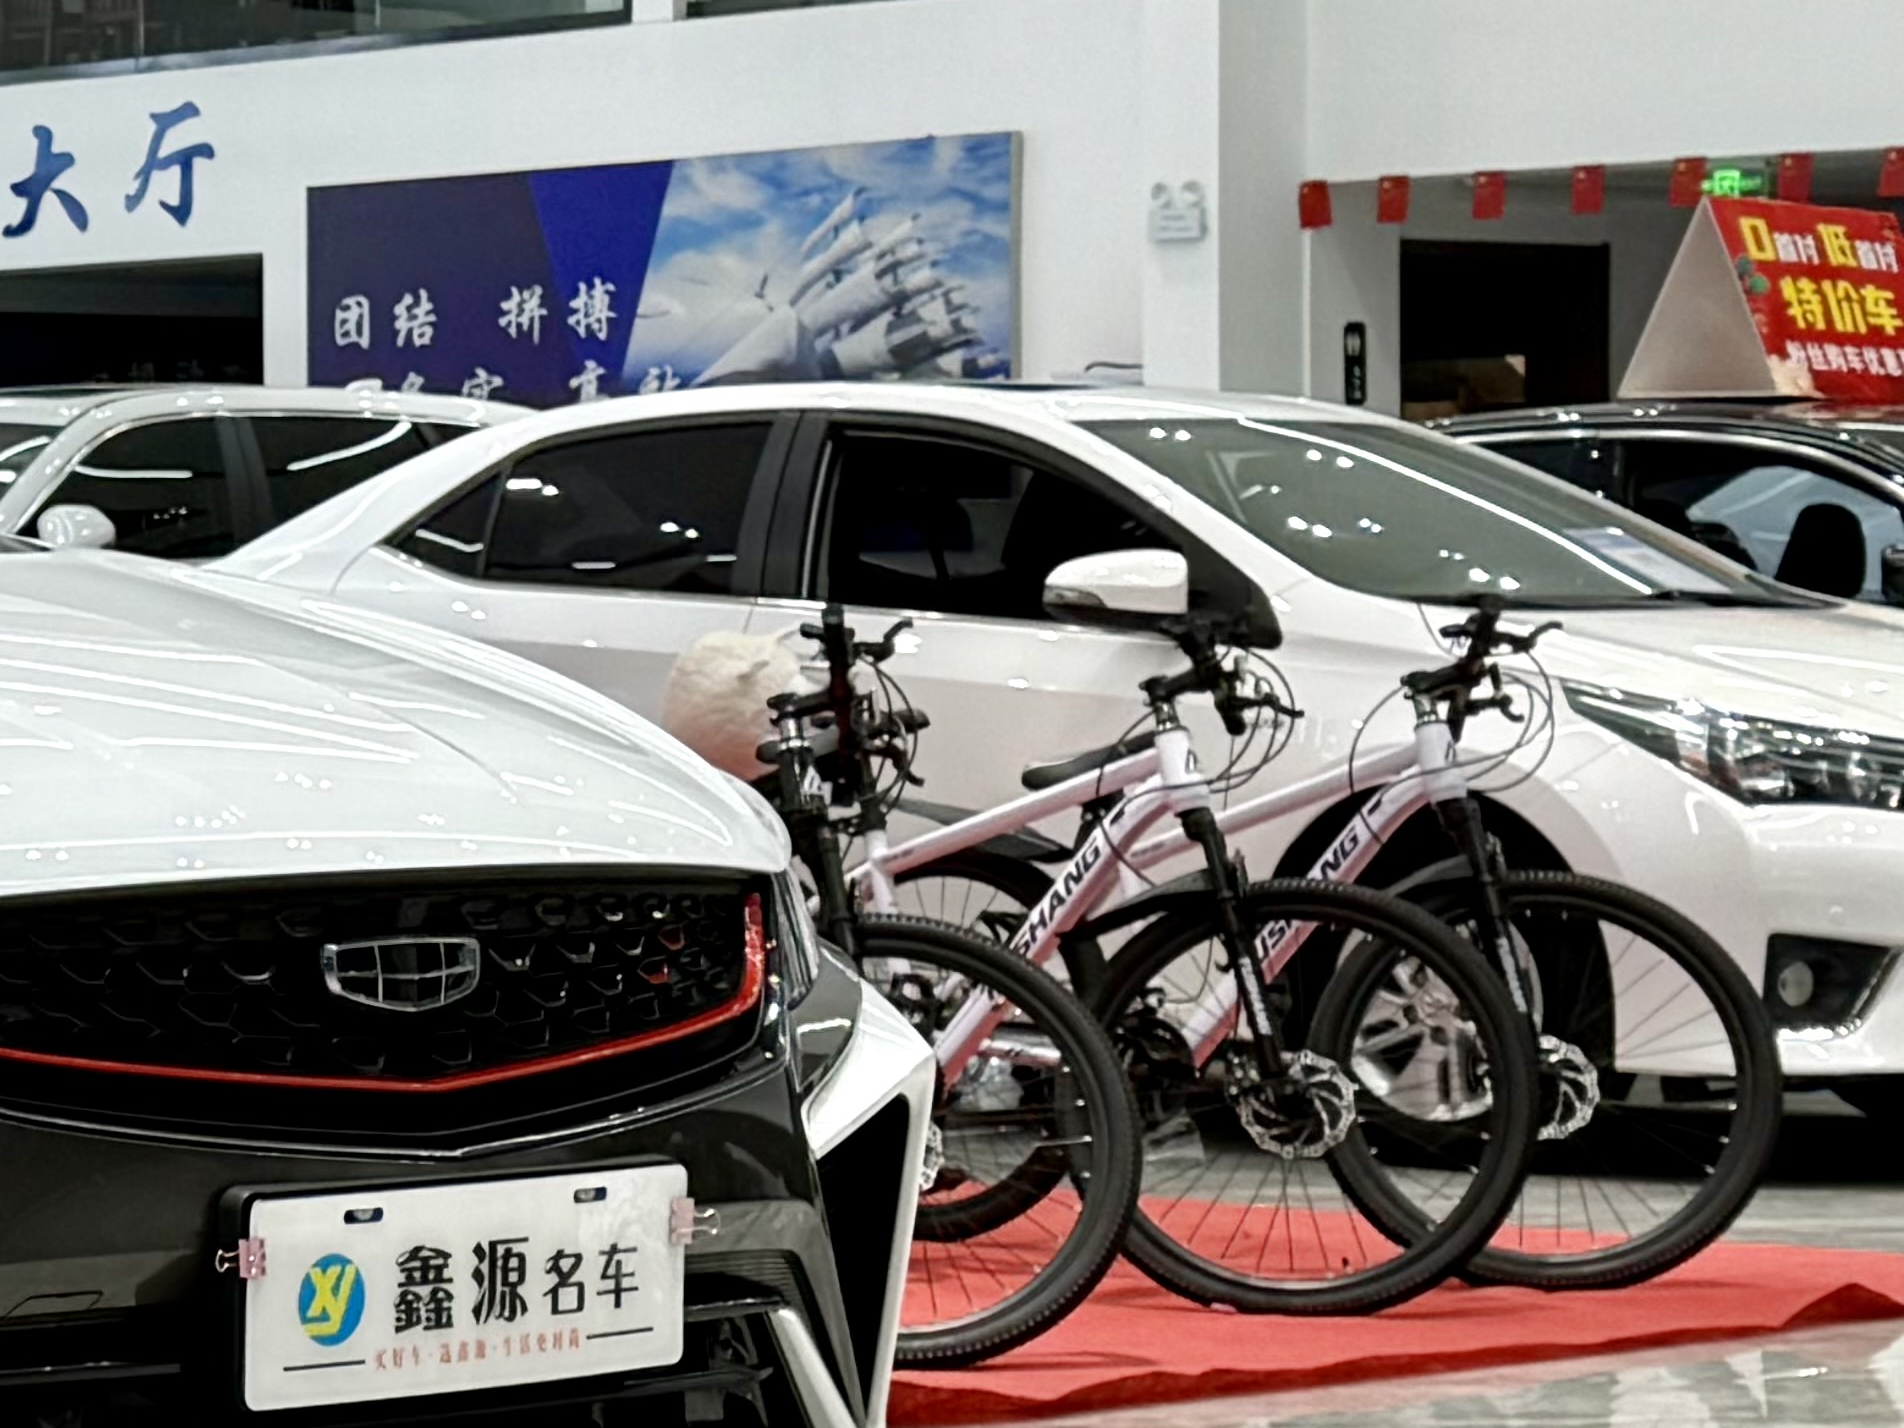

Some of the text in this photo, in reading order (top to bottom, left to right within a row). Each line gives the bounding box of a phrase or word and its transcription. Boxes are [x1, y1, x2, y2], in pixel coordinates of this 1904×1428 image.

[334, 275, 620, 350] 团结 拼搏
[393, 1236, 640, 1335] 鑫源名车
